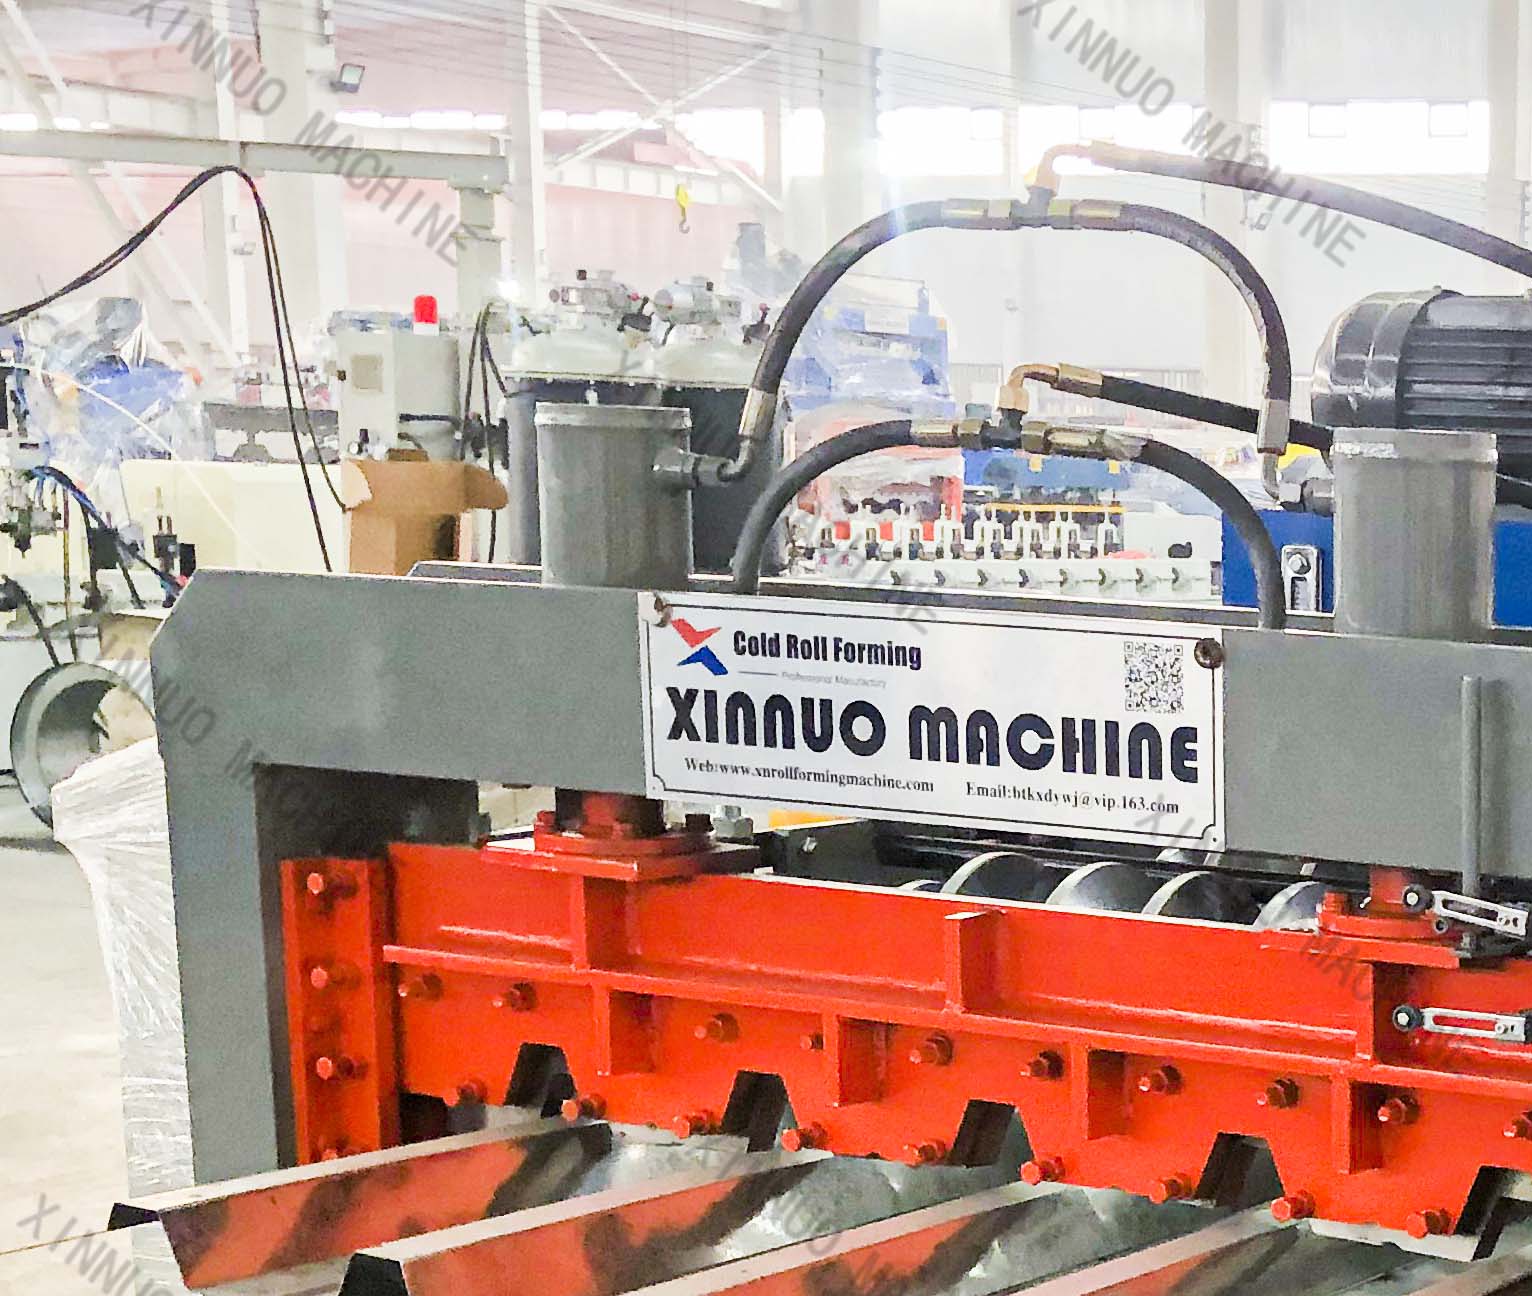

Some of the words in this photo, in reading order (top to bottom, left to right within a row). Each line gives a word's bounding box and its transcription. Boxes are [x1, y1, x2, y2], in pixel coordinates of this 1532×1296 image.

[733, 630, 780, 658] Cold
[786, 634, 828, 662] Roll
[833, 637, 922, 671] Forming
[666, 687, 886, 756] XINNUO
[908, 705, 1199, 783] MACHINE
